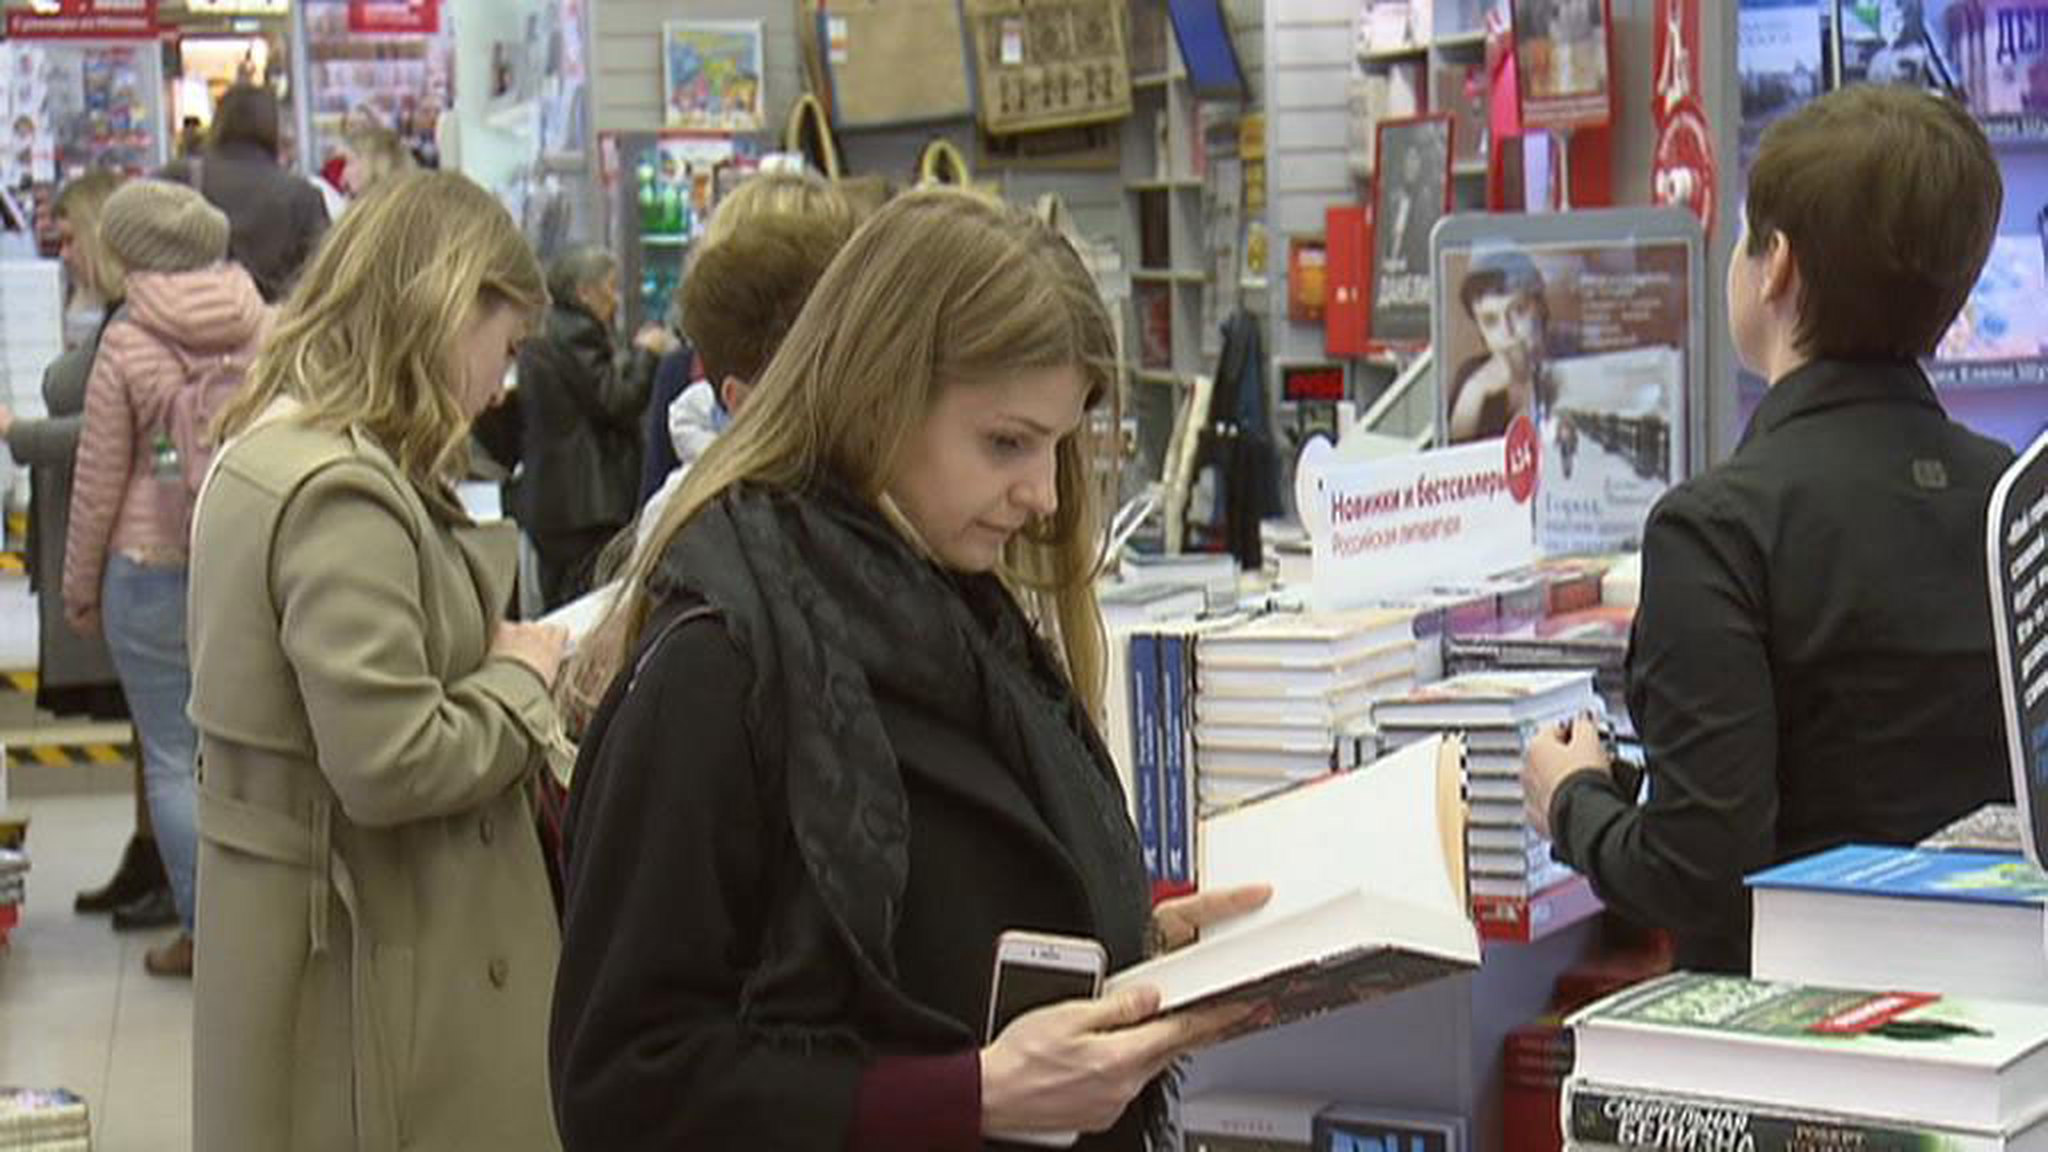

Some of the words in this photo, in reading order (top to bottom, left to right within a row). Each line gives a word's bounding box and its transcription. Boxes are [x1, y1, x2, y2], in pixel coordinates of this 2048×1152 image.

[1330, 485, 1400, 524] Новинки
[1404, 485, 1415, 505] и
[1602, 1095, 1749, 1134] СМЕРТЕЛЬНАЯ
[1617, 1118, 1758, 1152] БЕЛИЗНА
